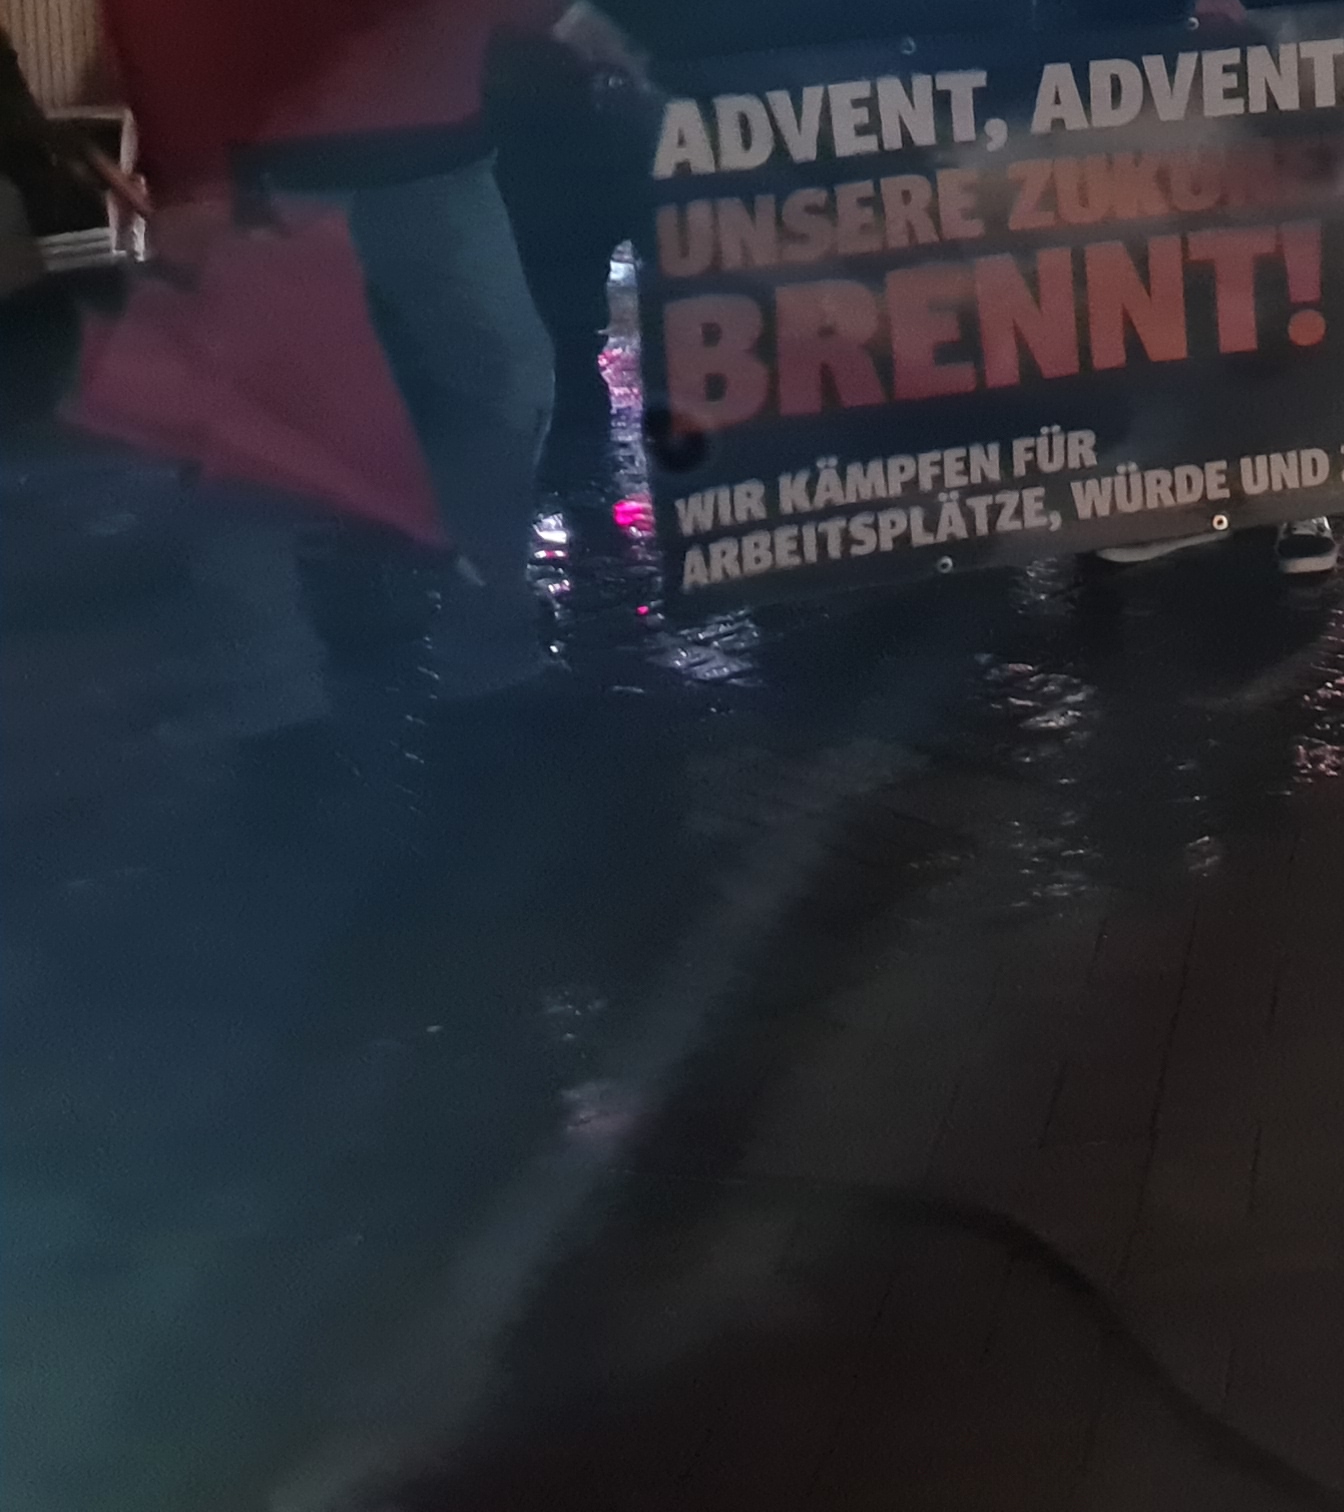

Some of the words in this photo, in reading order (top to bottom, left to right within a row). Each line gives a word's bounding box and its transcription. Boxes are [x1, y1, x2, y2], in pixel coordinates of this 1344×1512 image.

[651, 68, 1009, 179] ADVENT,
[656, 166, 985, 278] UNSERE
[662, 219, 1326, 436] BRENNT!
[675, 478, 767, 538] WIR
[778, 438, 1002, 515] KÄMPFEN
[1012, 426, 1098, 476] FÜR
[681, 488, 1063, 594] ARBEITSPLÄTZE,
[1072, 458, 1229, 521] WÜRDE
[1240, 446, 1328, 494] UND
